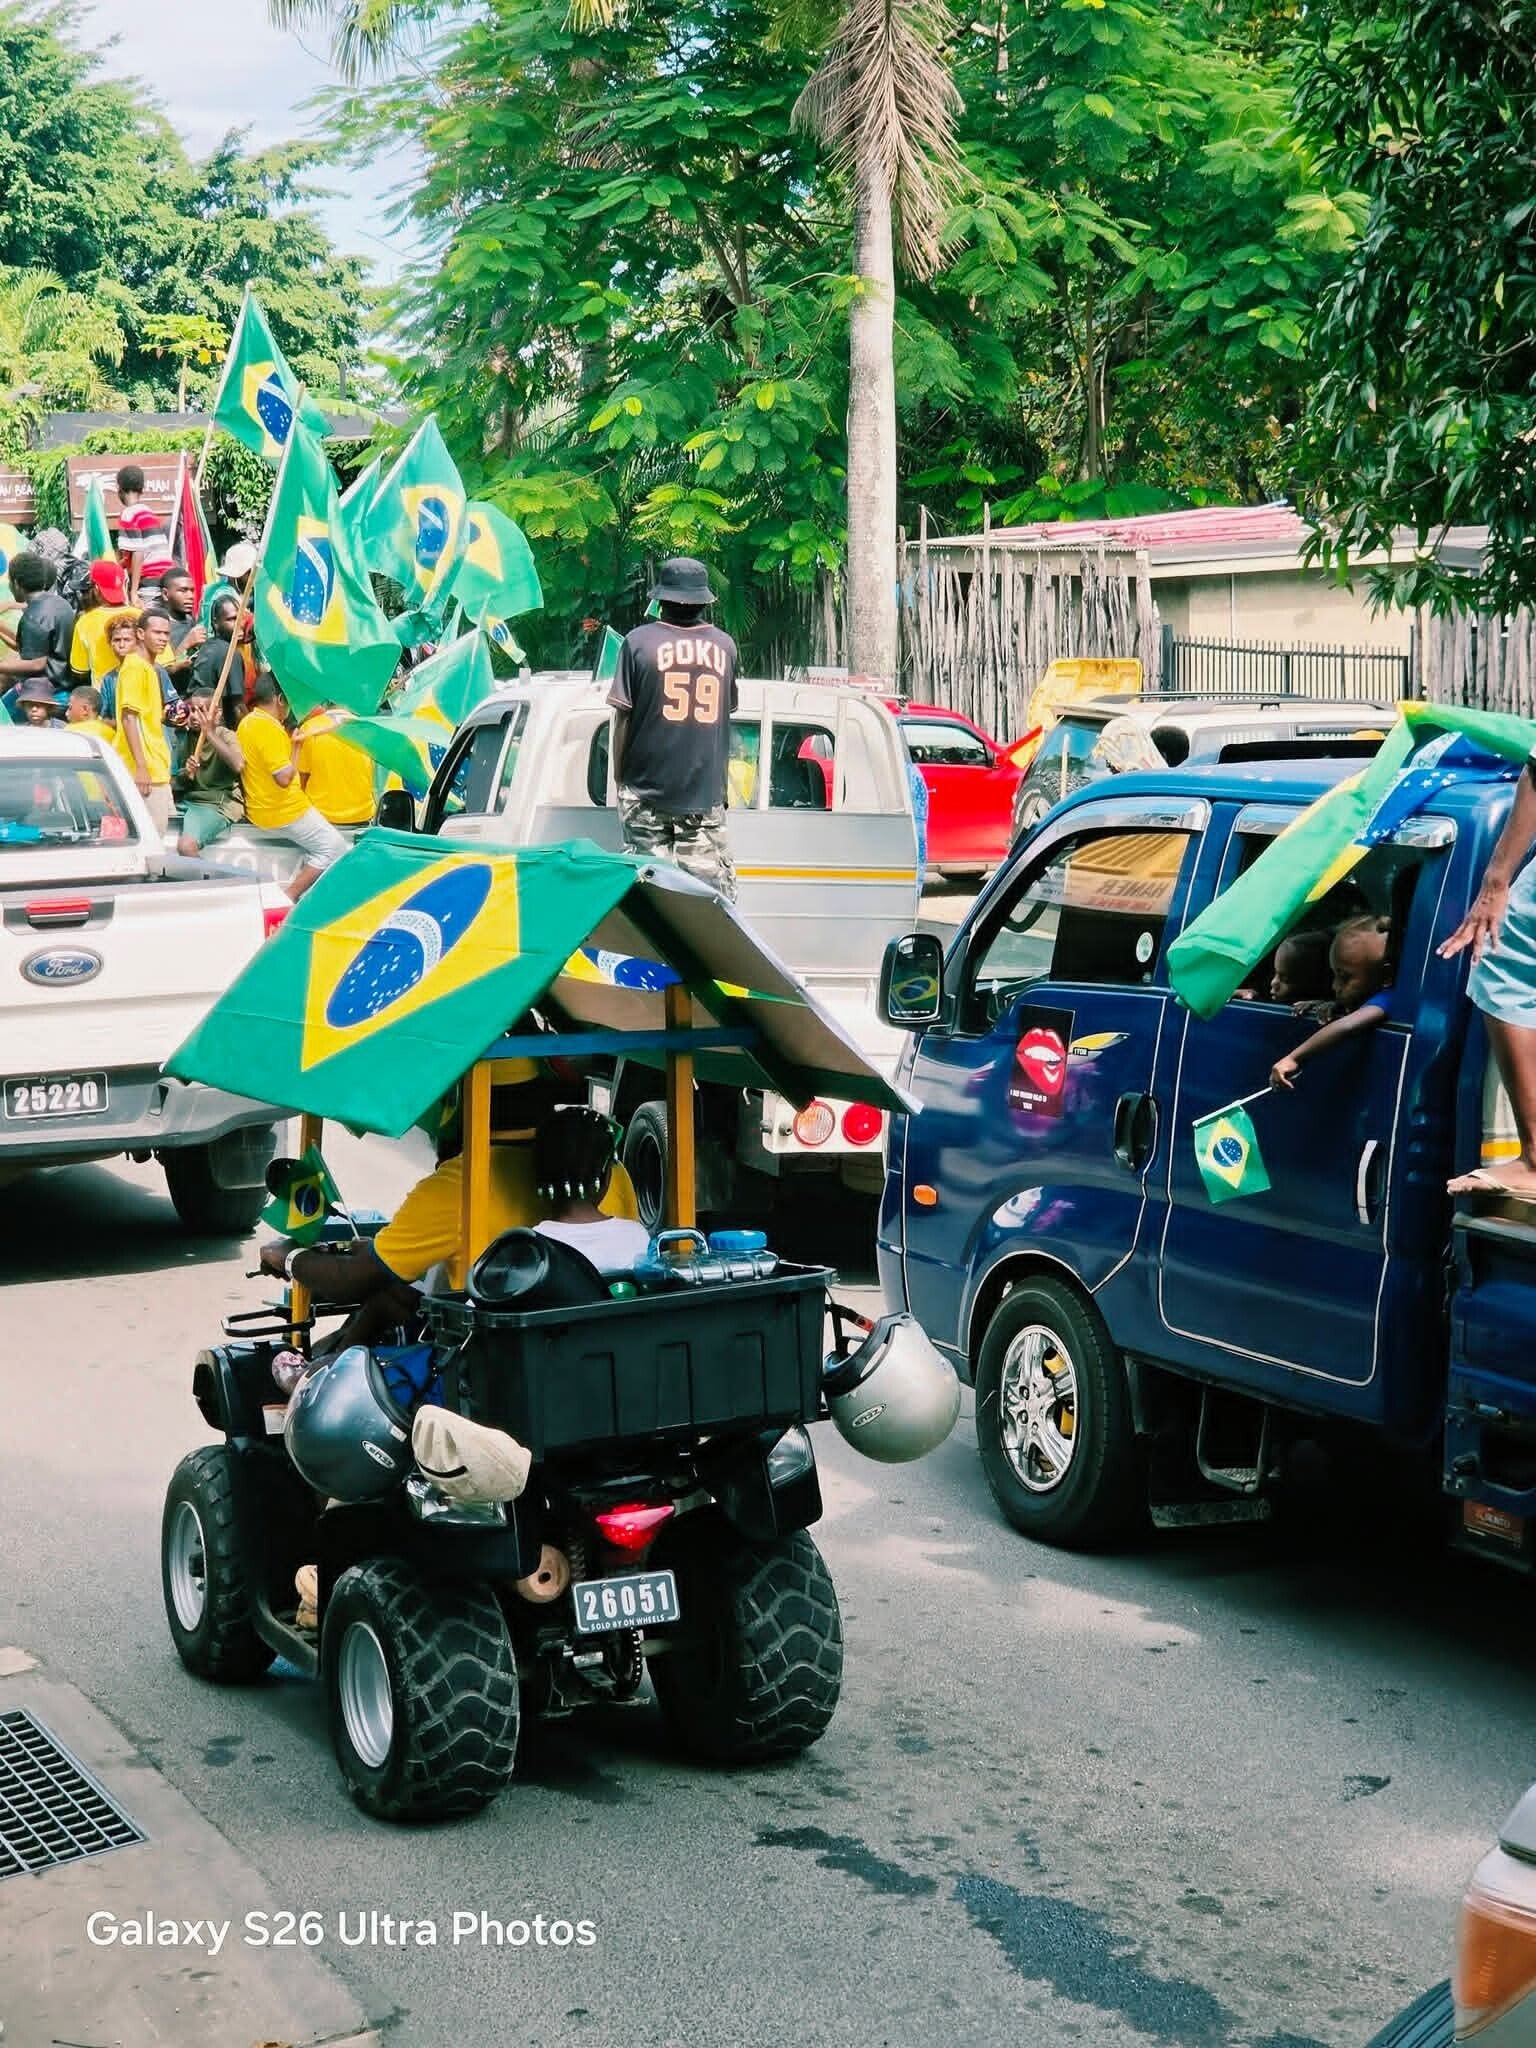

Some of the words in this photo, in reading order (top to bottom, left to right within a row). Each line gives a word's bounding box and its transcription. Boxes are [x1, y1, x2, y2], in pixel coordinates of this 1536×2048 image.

[656, 639, 727, 676] GOKU
[662, 672, 720, 724] 59
[45, 958, 83, 977] Ford
[13, 1081, 98, 1113] 25220
[583, 1581, 670, 1621] 26051
[591, 1622, 611, 1632] SOLD
[612, 1620, 622, 1628] BY
[623, 1618, 635, 1627] ON
[636, 1614, 665, 1626] WHEELS
